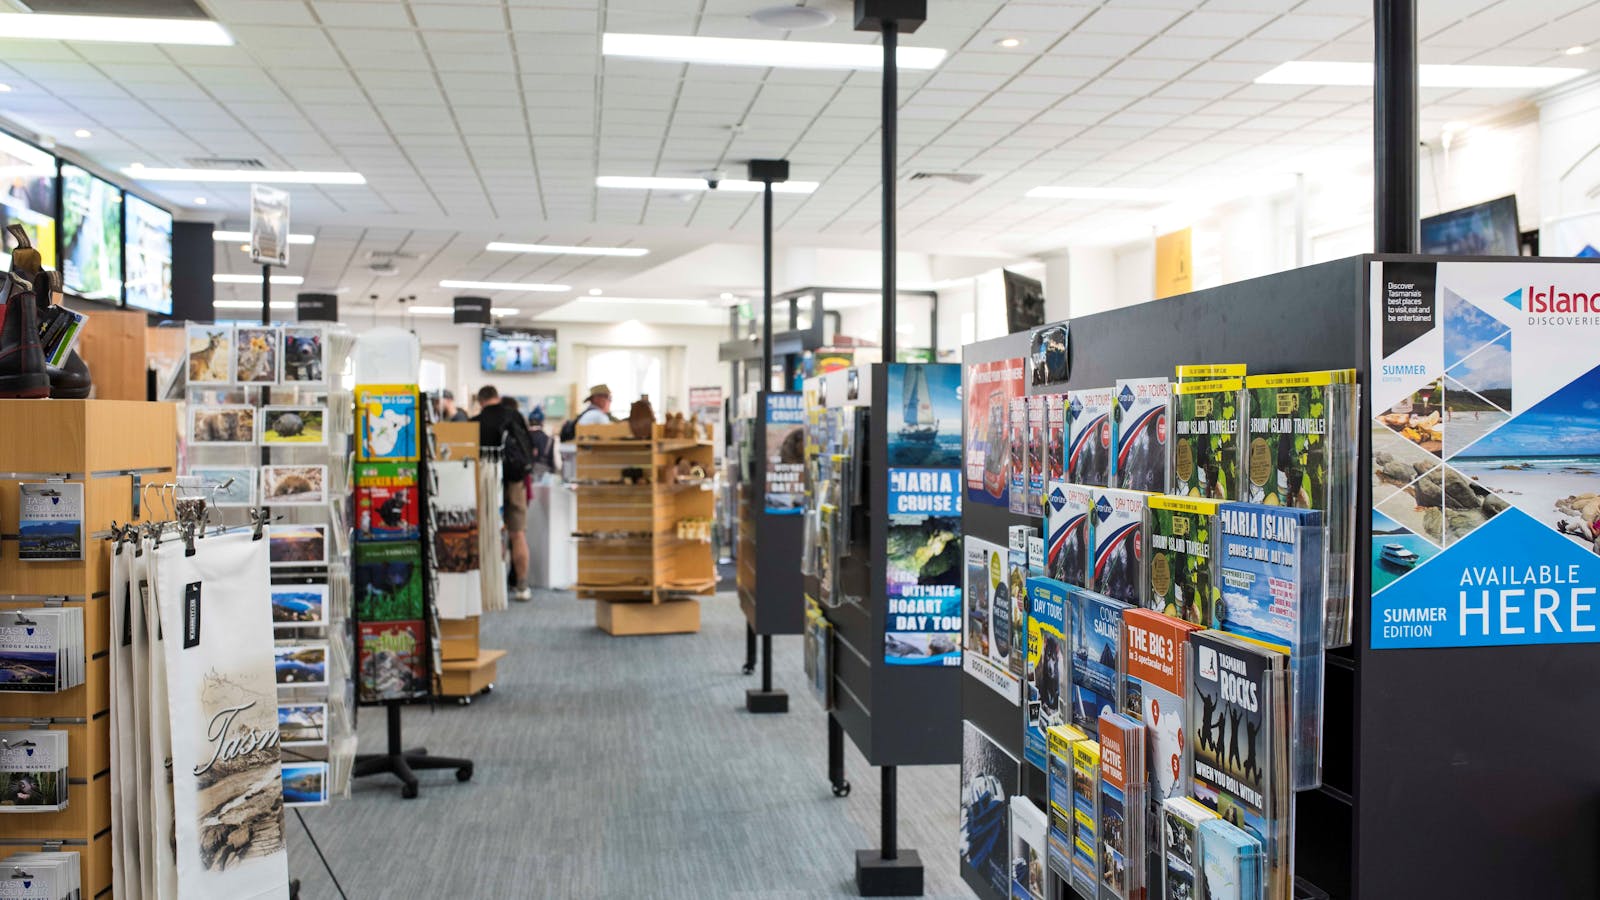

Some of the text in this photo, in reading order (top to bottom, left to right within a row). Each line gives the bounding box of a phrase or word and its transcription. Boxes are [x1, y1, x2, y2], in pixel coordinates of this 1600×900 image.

[1388, 282, 1414, 290] Discover
[1388, 290, 1422, 298] Tasmania's
[1402, 298, 1422, 306] places
[1417, 306, 1430, 314] and
[1388, 314, 1431, 322] be entertained
[1382, 365, 1426, 375] SUMMER
[1271, 418, 1291, 434] ISLAND
[891, 471, 952, 492] MARIA
[898, 495, 952, 512] CRUISE
[1221, 509, 1258, 539] MARIA
[1228, 543, 1248, 558] CRUISE
[1254, 548, 1269, 562] WALK
[1459, 564, 1580, 586] AVAILABLE
[902, 585, 955, 598] ULTIMATE
[888, 599, 943, 614] HOBART
[1034, 598, 1062, 621] DAY TOURS
[1383, 607, 1447, 623] SUMMER
[1459, 587, 1597, 636] HERE
[896, 616, 927, 631] DAY
[1100, 606, 1118, 626] COME
[1383, 625, 1432, 638] EDITION
[1128, 625, 1148, 653] THE
[1149, 632, 1166, 660] BIG
[1167, 639, 1174, 663] 3
[972, 660, 985, 675] BOOK
[986, 669, 997, 685] HERE
[1134, 651, 1138, 661] 3
[1138, 655, 1162, 671] spectacular
[1162, 662, 1174, 677] days!
[1219, 652, 1247, 677] TASMANIA
[1221, 671, 1258, 713] ROCKS
[1153, 705, 1158, 716] 1
[1102, 746, 1122, 770] ACTIVE
[1173, 759, 1178, 771] 3
[1109, 764, 1123, 782] TOURS
[1195, 760, 1262, 810] WHEN YOU ROLL WITH US
